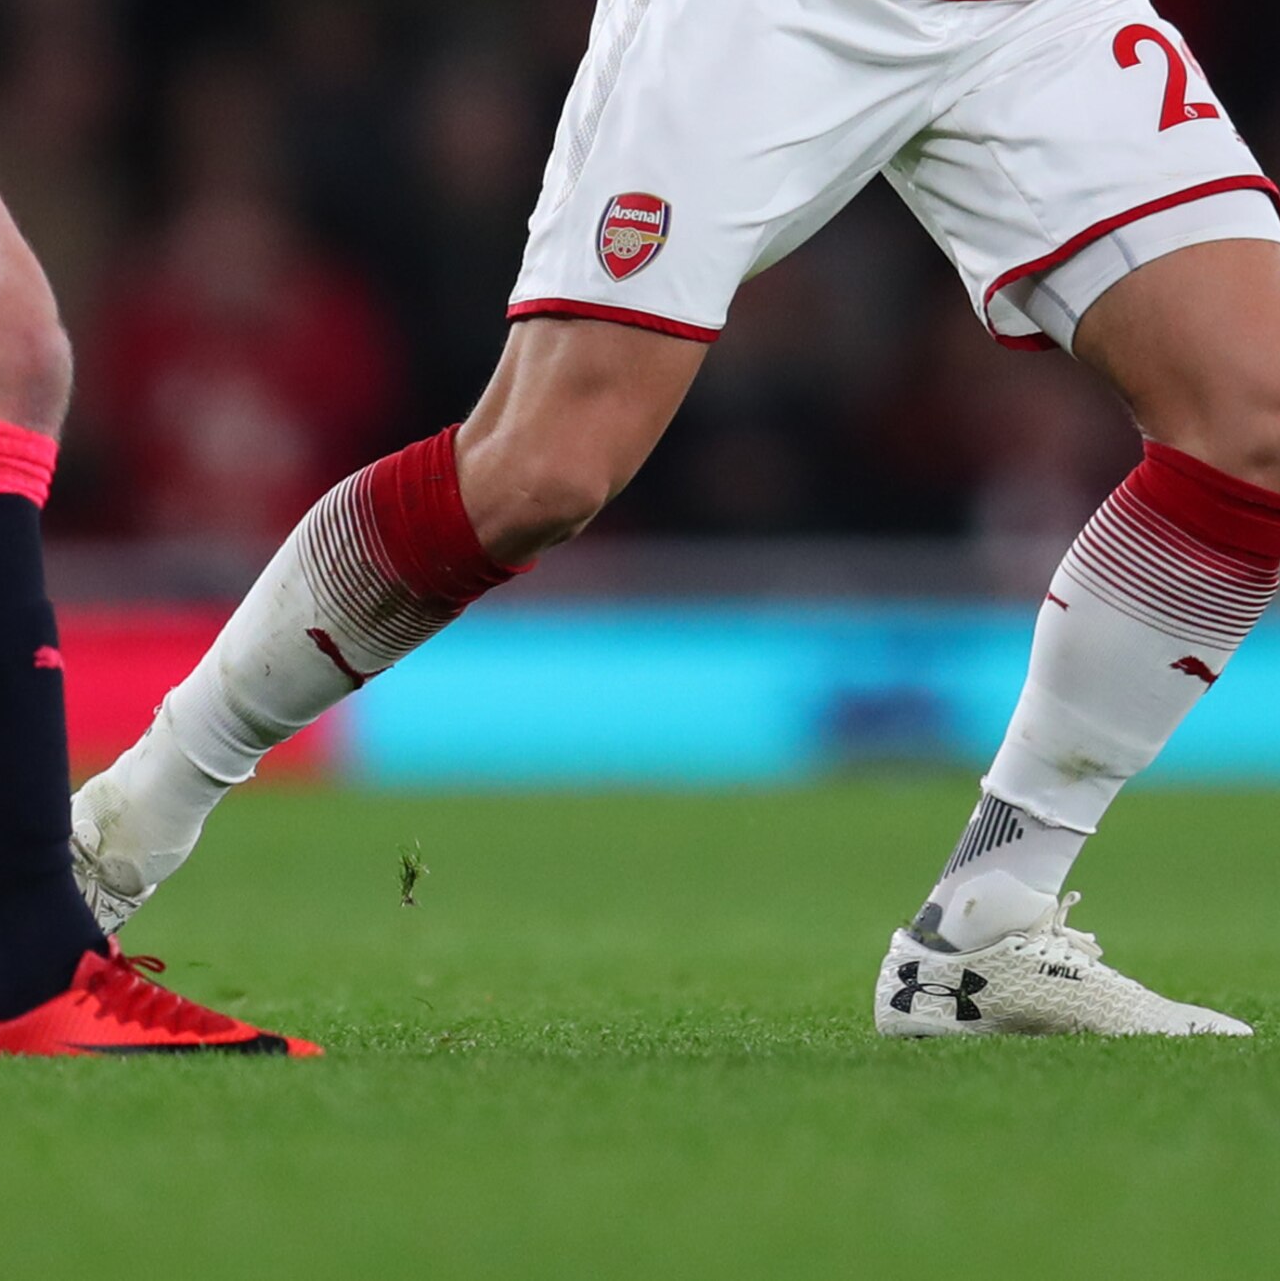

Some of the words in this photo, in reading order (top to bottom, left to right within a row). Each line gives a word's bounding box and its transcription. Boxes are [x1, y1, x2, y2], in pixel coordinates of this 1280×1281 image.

[1111, 22, 1230, 134] 2
[609, 204, 661, 225] Arsenal
[1047, 963, 1083, 982] WILL
